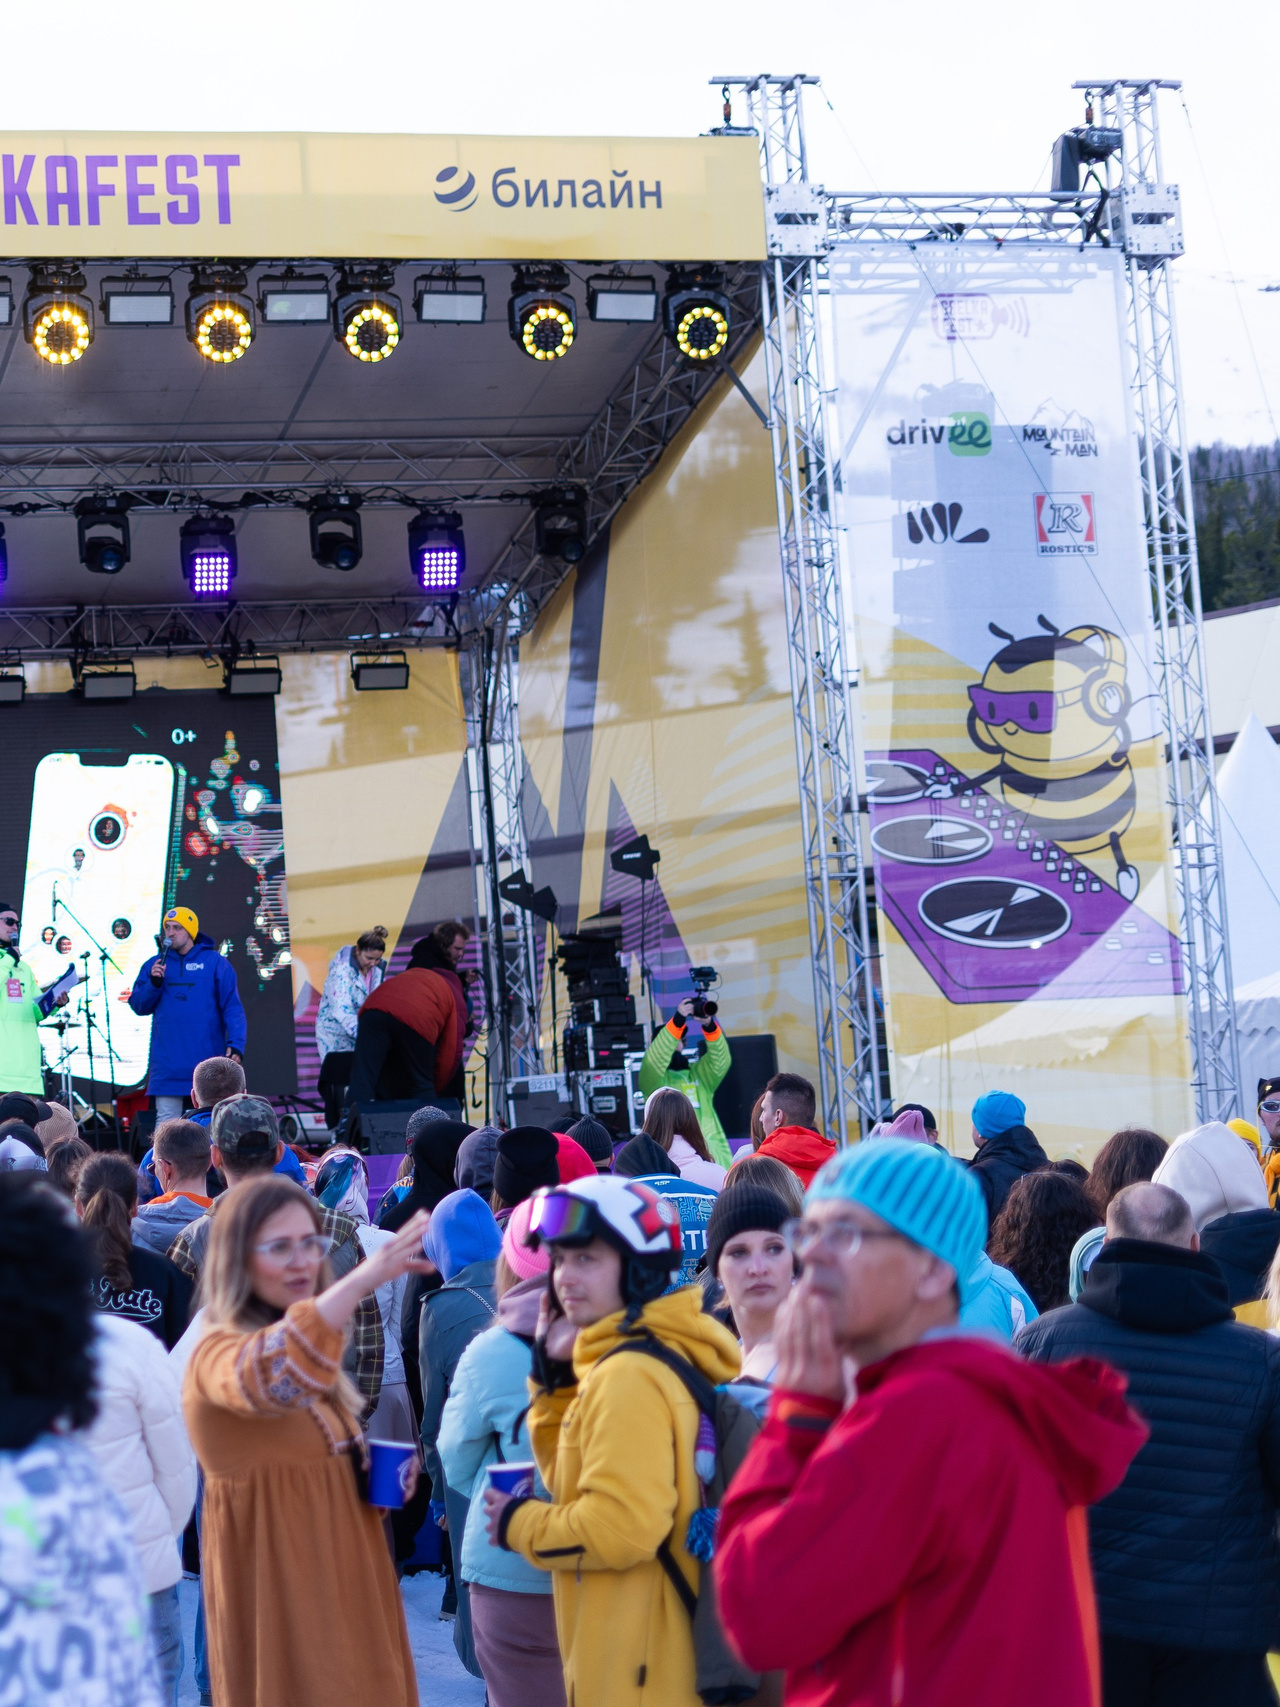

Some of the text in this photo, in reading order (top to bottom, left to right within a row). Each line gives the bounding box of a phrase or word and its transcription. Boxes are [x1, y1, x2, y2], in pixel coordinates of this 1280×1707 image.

[492, 167, 664, 210] билайн
[886, 417, 992, 448] drivee
[1023, 427, 1096, 442] MOUNTAIN
[1065, 443, 1098, 457] MAN
[1041, 544, 1096, 554] ROSTIC'S
[171, 728, 197, 745] 0+
